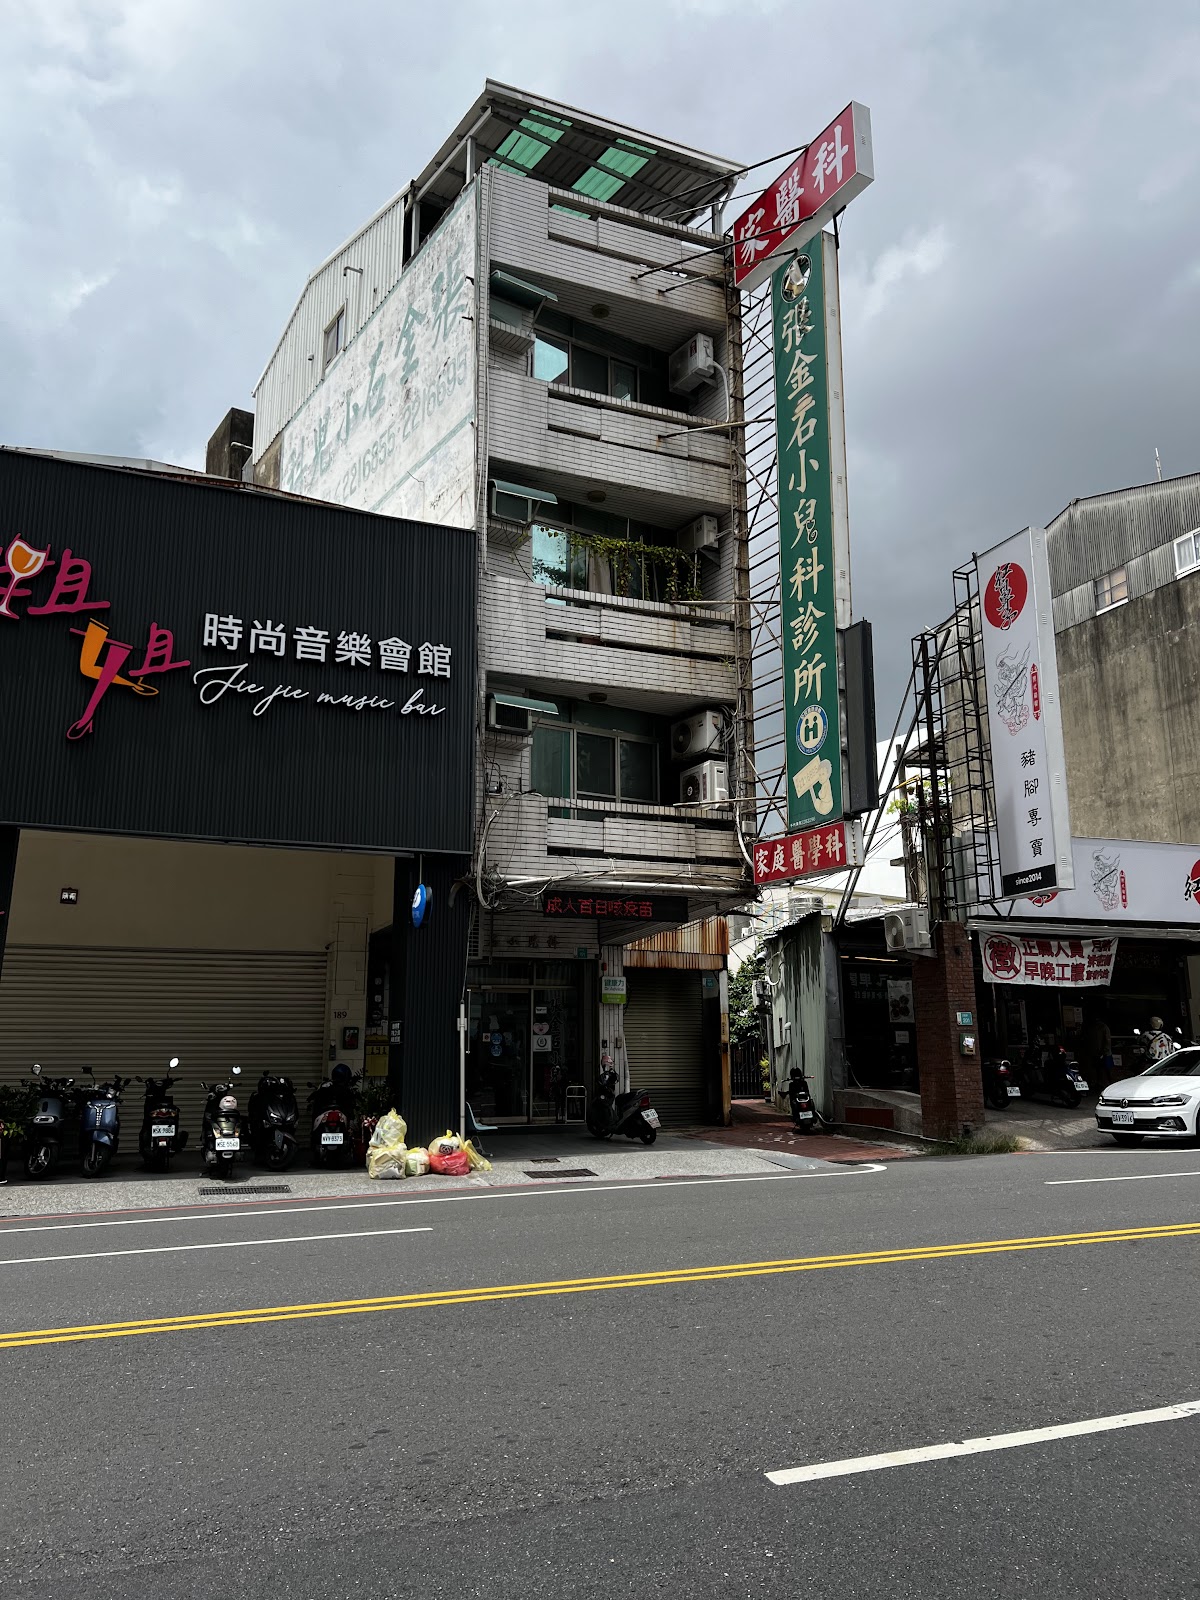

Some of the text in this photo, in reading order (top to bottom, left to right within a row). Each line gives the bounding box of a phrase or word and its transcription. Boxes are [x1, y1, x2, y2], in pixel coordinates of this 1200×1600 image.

[739, 124, 849, 267] 家醫科
[781, 296, 827, 707] 張金石小兒科診所
[202, 612, 453, 679] 時尚音樂會館
[317, 687, 396, 711] music
[400, 688, 447, 717] bar
[754, 829, 843, 878] 家庭醫學科
[1015, 872, 1043, 886] since2014
[546, 897, 653, 918] 成人百日咳疫苗
[988, 939, 1021, 975] 徵
[1021, 938, 1086, 959] 正職人員
[1024, 961, 1086, 982] 早晚工讀
[334, 1011, 347, 1019] 189
